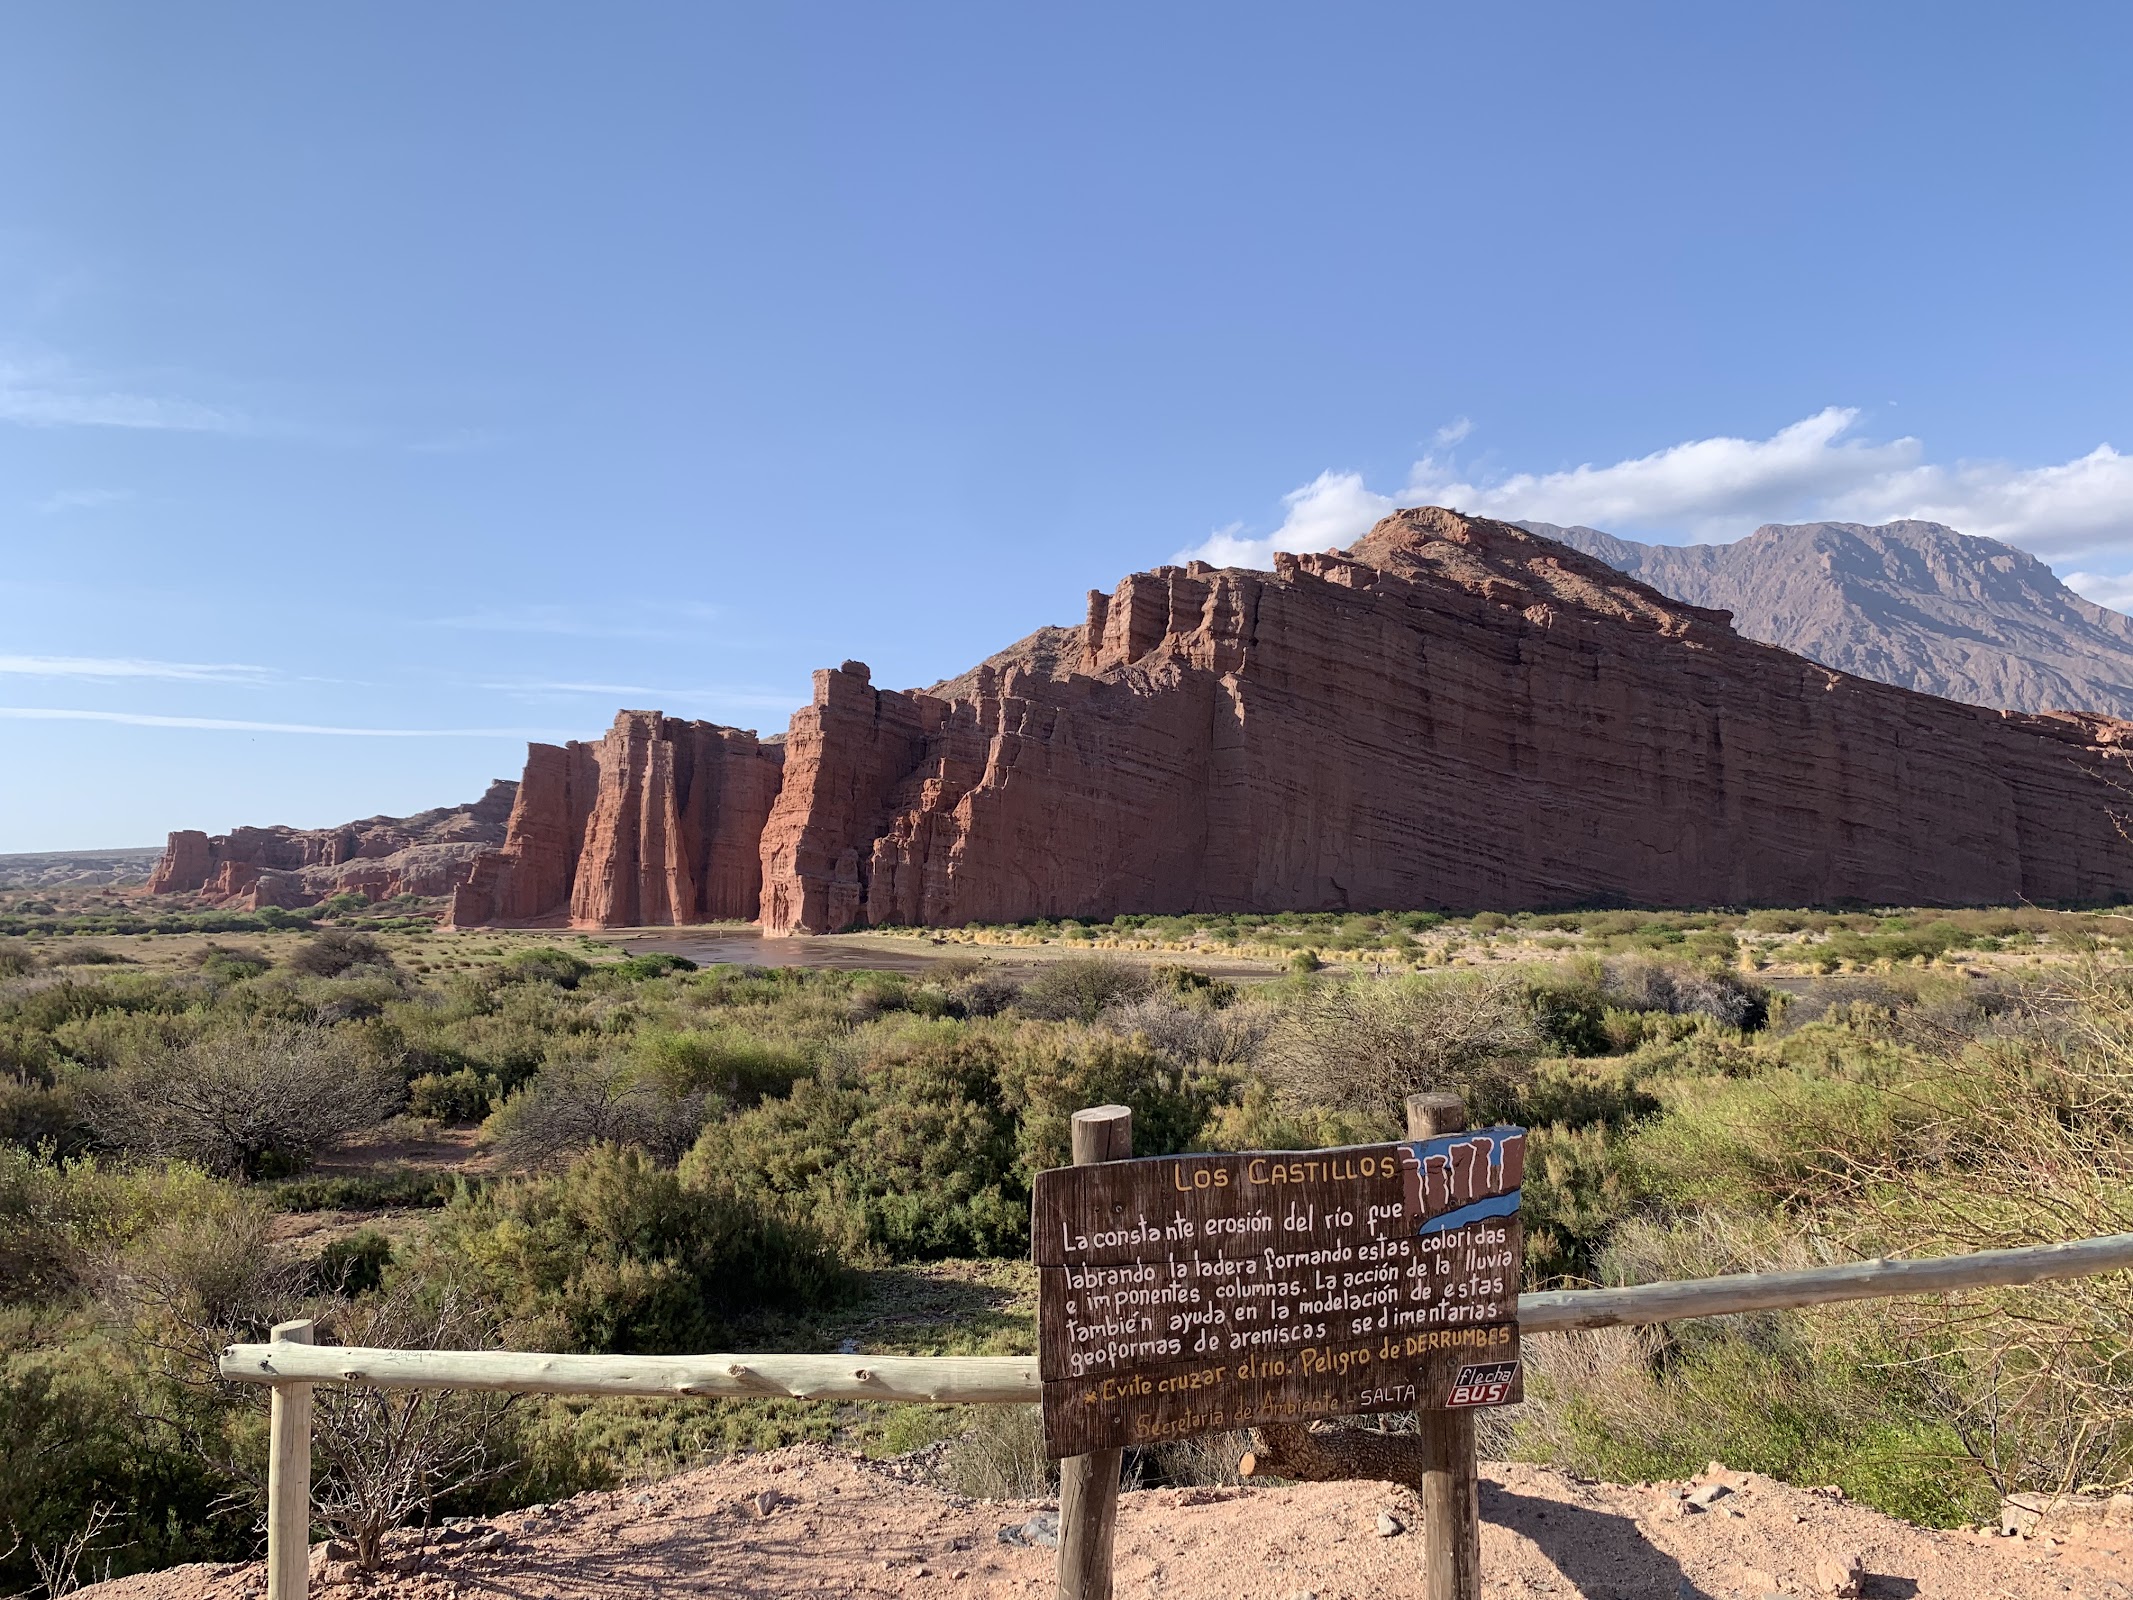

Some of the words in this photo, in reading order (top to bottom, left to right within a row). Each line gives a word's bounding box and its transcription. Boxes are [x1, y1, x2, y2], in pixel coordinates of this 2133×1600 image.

[1175, 1163, 1229, 1192] LOS
[1249, 1157, 1395, 1187] CASTILLOS
[1063, 1222, 1088, 1252] La
[1093, 1213, 1194, 1249] constante
[1205, 1209, 1272, 1236] erosión
[1284, 1201, 1313, 1232] del
[1325, 1206, 1354, 1229] río
[1367, 1202, 1403, 1236] fue
[1063, 1255, 1155, 1291] labrando
[1169, 1251, 1188, 1278] la
[1194, 1249, 1257, 1278] ladera
[1264, 1239, 1352, 1280] formando
[1358, 1232, 1410, 1260] estas
[1421, 1224, 1506, 1254] coloridas
[1066, 1299, 1077, 1315] e
[1086, 1280, 1200, 1315] imponentes
[1215, 1276, 1307, 1300] columnas.
[1315, 1270, 1337, 1290] La
[1343, 1262, 1399, 1288] acción
[1406, 1256, 1428, 1278] de
[1435, 1253, 1450, 1276] la
[1465, 1248, 1513, 1272] lluvia
[1066, 1311, 1153, 1343] también
[1169, 1300, 1226, 1334] ayuda
[1235, 1304, 1258, 1321] en
[1271, 1299, 1290, 1320] la
[1299, 1283, 1398, 1316] modelación
[1410, 1278, 1432, 1300] de
[1444, 1273, 1504, 1299] estas
[1070, 1337, 1181, 1377] geoformas
[1194, 1328, 1219, 1353] de
[1229, 1321, 1326, 1350] areniscas
[1102, 1374, 1152, 1402] Evite
[1158, 1366, 1226, 1392] cruzar
[1300, 1346, 1370, 1377] Peligro
[1379, 1336, 1400, 1360] de
[1405, 1326, 1510, 1356] DERRUMBES
[1459, 1365, 1512, 1386] flecha
[1136, 1406, 1224, 1438] Secretaria
[1234, 1395, 1252, 1421] de
[1262, 1389, 1339, 1418] Ambiente
[1360, 1384, 1416, 1406] SALTA
[1453, 1384, 1503, 1404] BUS
